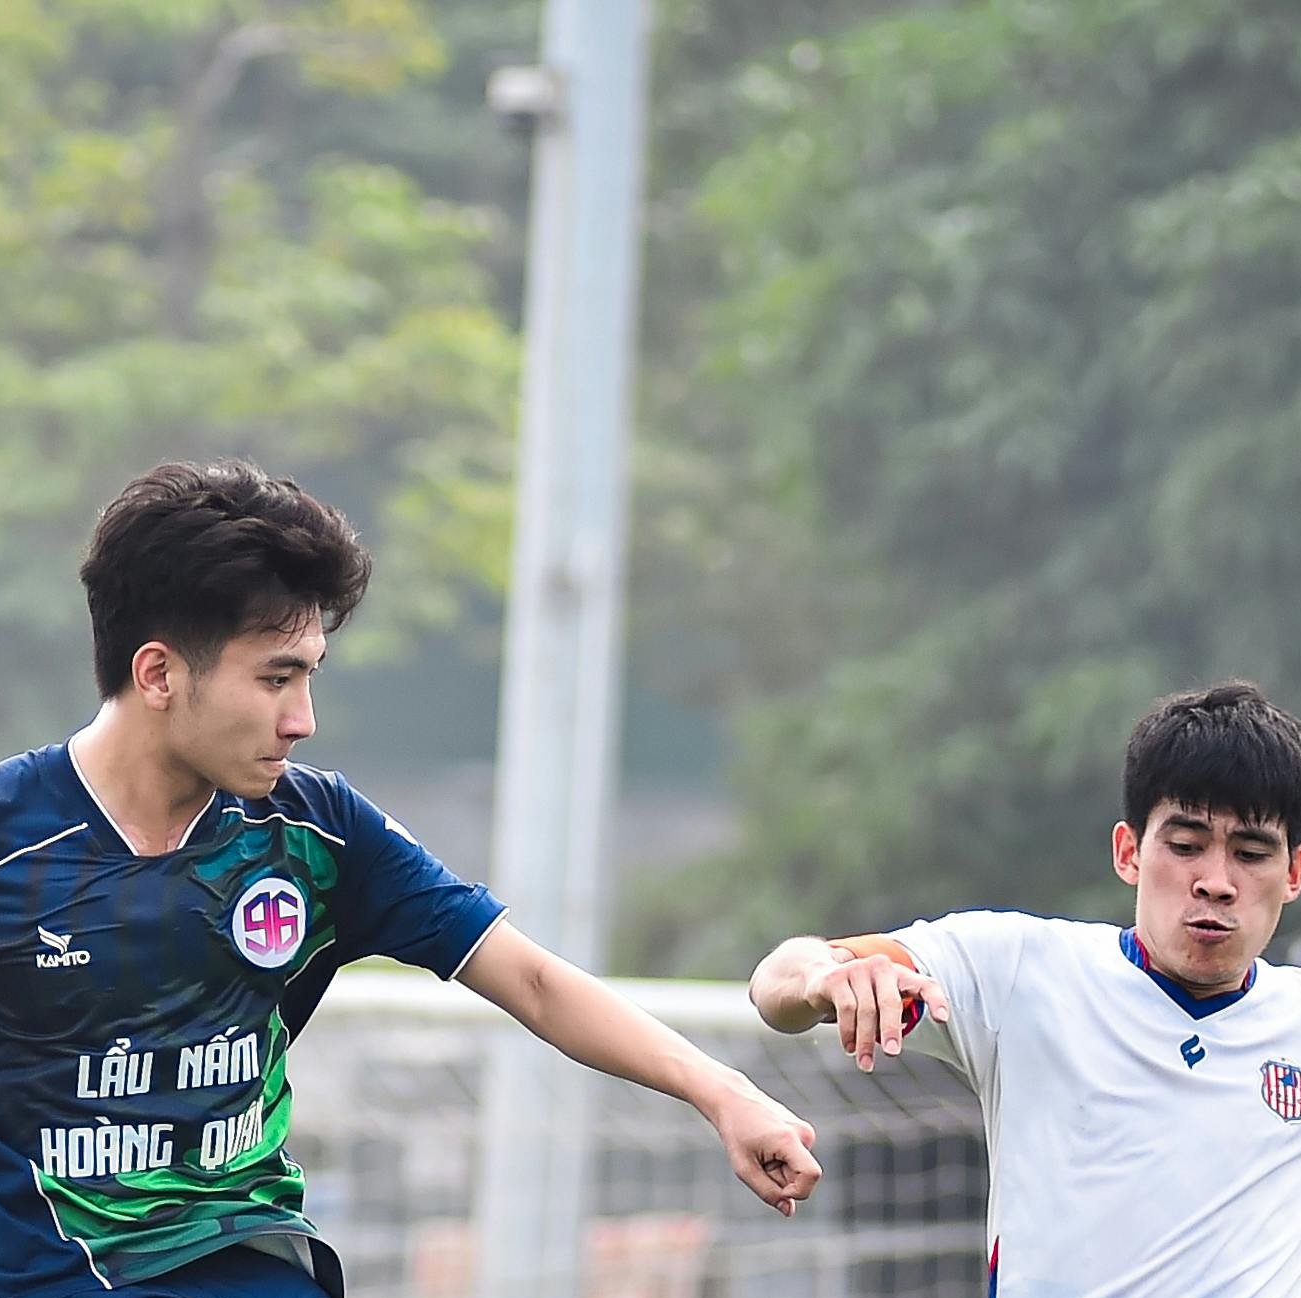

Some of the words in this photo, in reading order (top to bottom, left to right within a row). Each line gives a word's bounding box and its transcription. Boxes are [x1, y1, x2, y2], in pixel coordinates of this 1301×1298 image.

[242, 890, 299, 956] 96
[36, 950, 91, 968] KAMITO
[76, 1037, 154, 1099] LẨU
[176, 1025, 260, 1090] NẤM
[40, 1116, 174, 1178] HOÀNG
